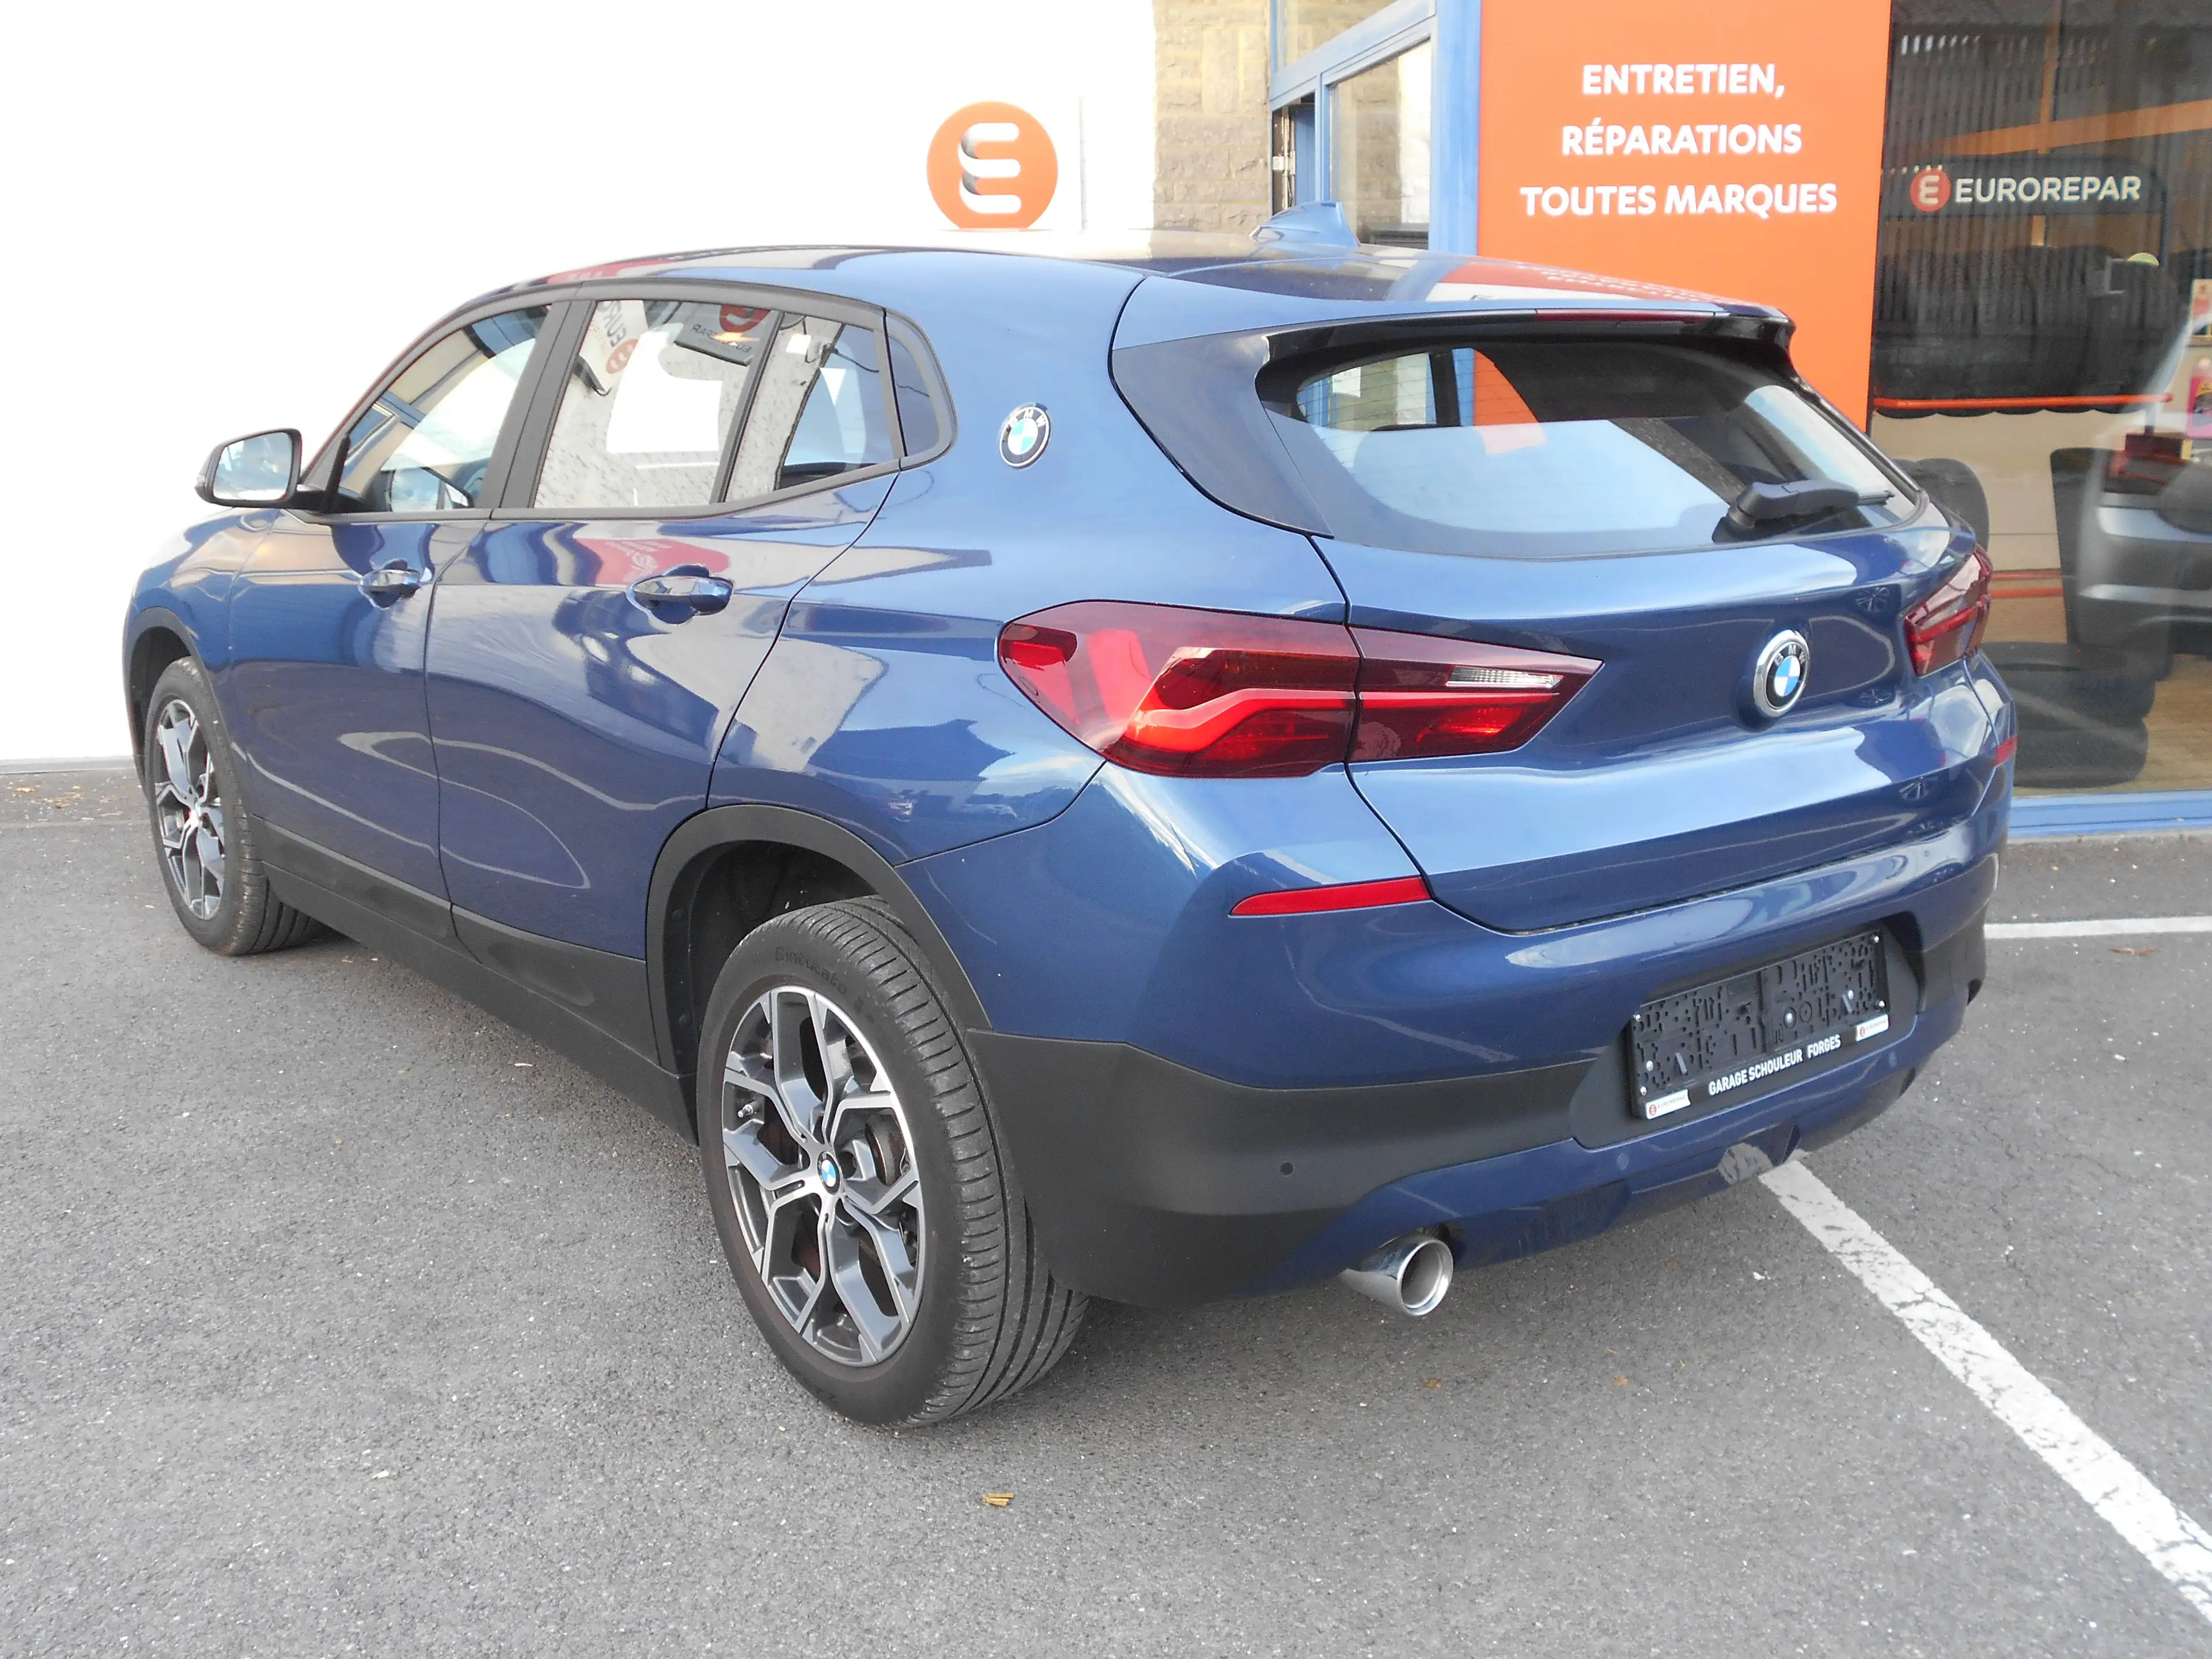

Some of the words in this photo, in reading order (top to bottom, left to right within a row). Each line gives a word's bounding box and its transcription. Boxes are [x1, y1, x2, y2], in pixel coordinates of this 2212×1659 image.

[1582, 63, 1785, 98] ENTRETIEN,
[1562, 118, 1802, 156] RÉPARATIONS
[1520, 185, 1656, 216] TOUTES
[1664, 183, 1837, 219] MARQUES
[1955, 176, 2142, 203] EUROREPAR
[1708, 1069, 1748, 1096] GARAGE
[1748, 1048, 1803, 1081] SCHOULEUR
[1806, 1034, 1842, 1059] FORGES
